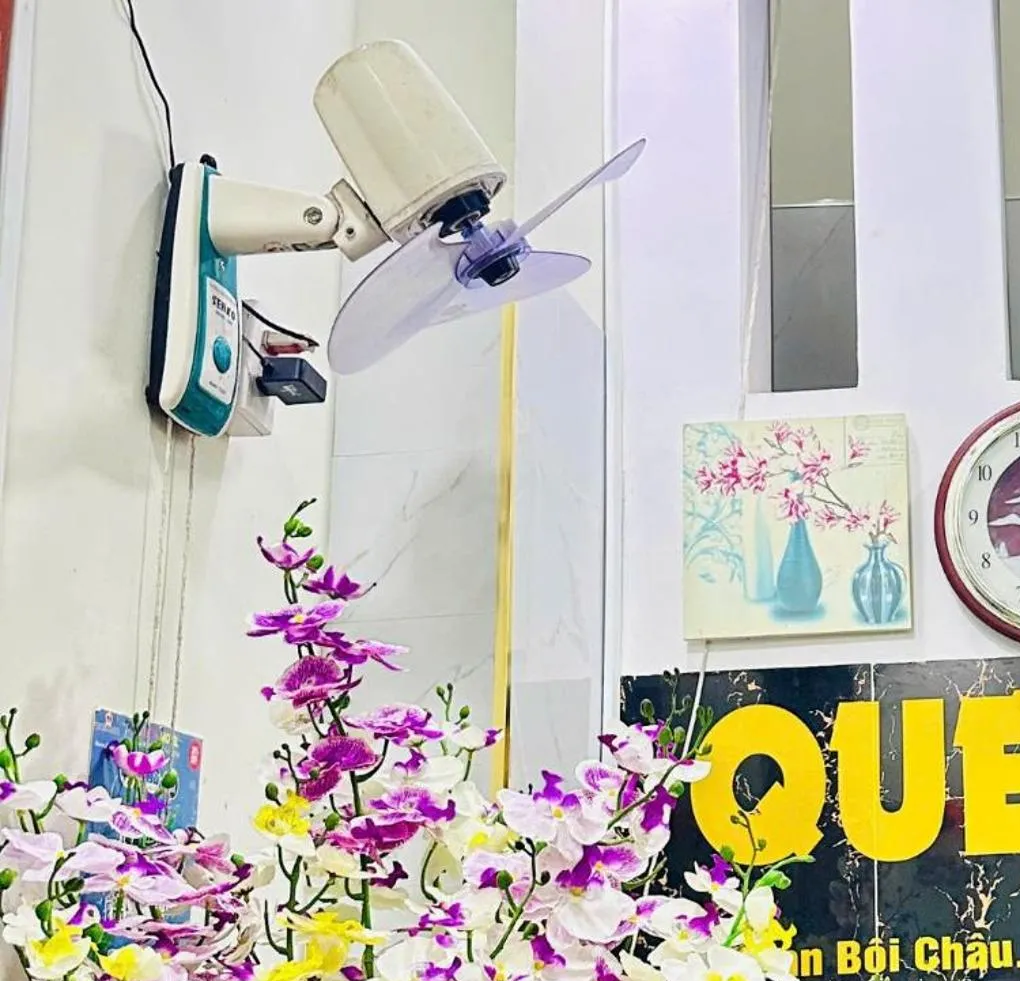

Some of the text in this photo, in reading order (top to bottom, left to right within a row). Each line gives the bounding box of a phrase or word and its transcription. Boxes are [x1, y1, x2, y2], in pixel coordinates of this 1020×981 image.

[978, 465, 993, 481] 10
[968, 509, 979, 525] 9
[981, 553, 992, 569] 8
